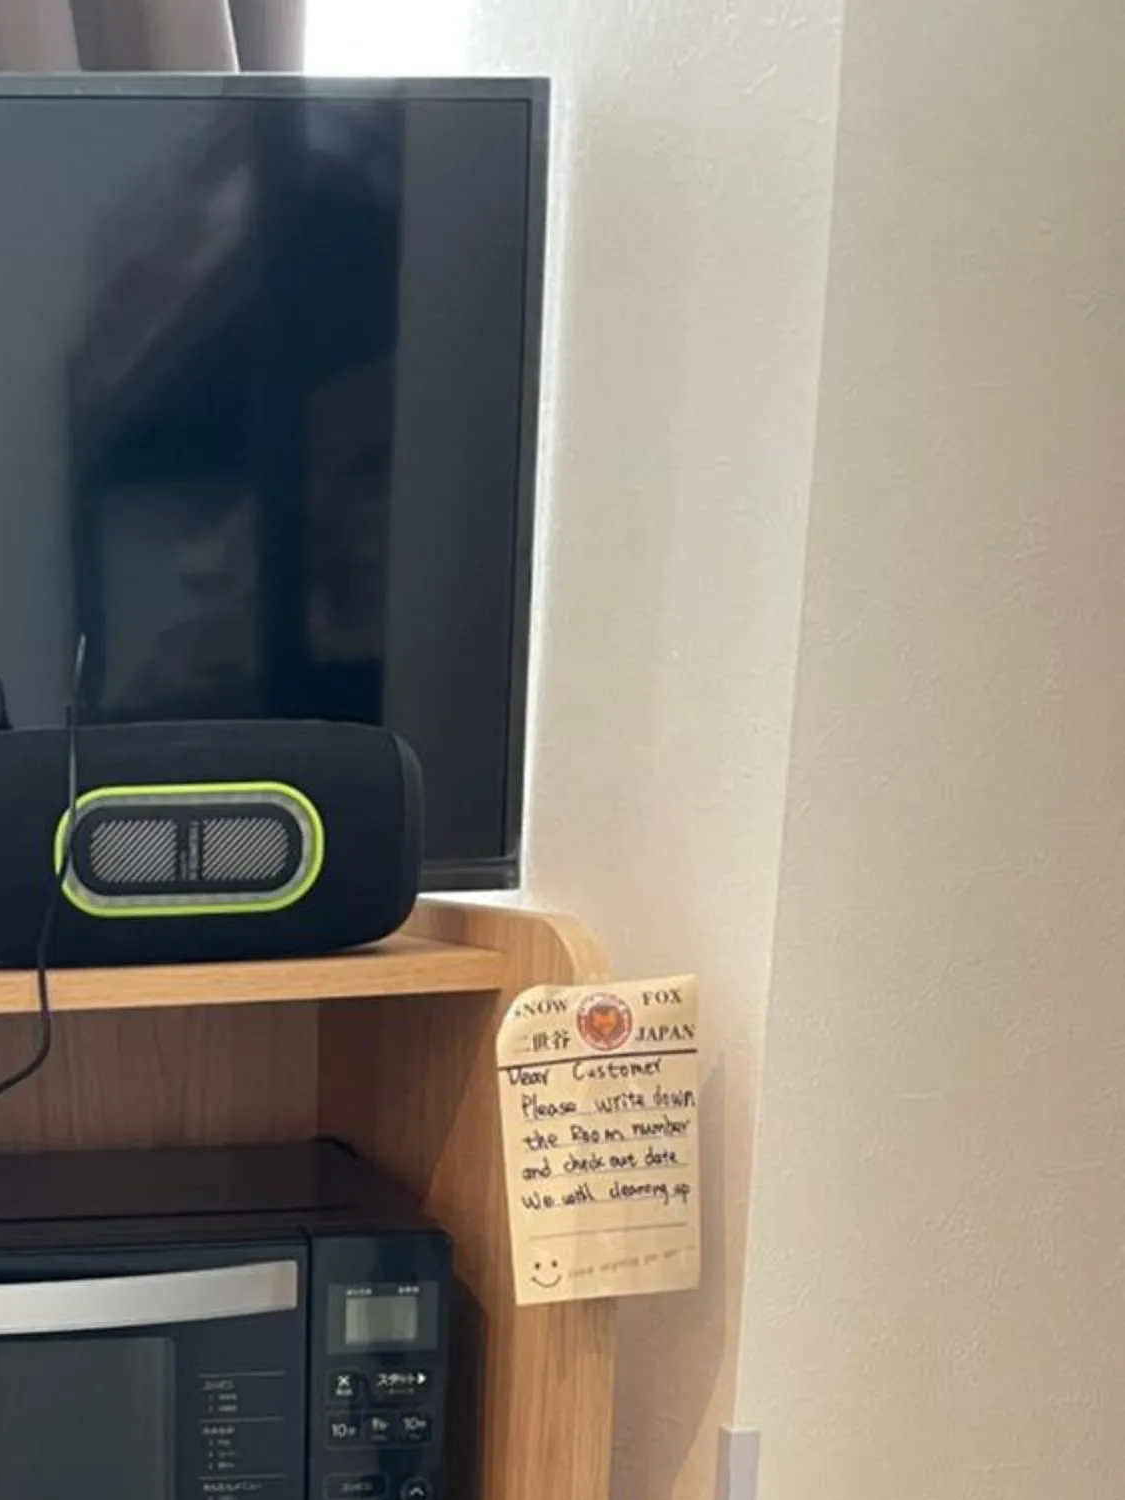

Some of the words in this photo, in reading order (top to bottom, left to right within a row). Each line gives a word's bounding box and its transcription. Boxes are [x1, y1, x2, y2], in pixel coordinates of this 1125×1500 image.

[642, 988, 682, 1006] FOX
[635, 1024, 696, 1042] JAPAN
[507, 1066, 550, 1086] Dear
[573, 1058, 662, 1081] Customer
[521, 1093, 577, 1119] Please
[595, 1091, 645, 1113] write
[653, 1084, 695, 1107] down
[522, 1129, 558, 1151] the
[632, 1114, 691, 1136] number
[522, 1156, 551, 1180] and
[645, 1145, 678, 1165] date
[521, 1190, 554, 1210] We
[609, 1180, 668, 1206] cleaning
[674, 1183, 690, 1202] up
